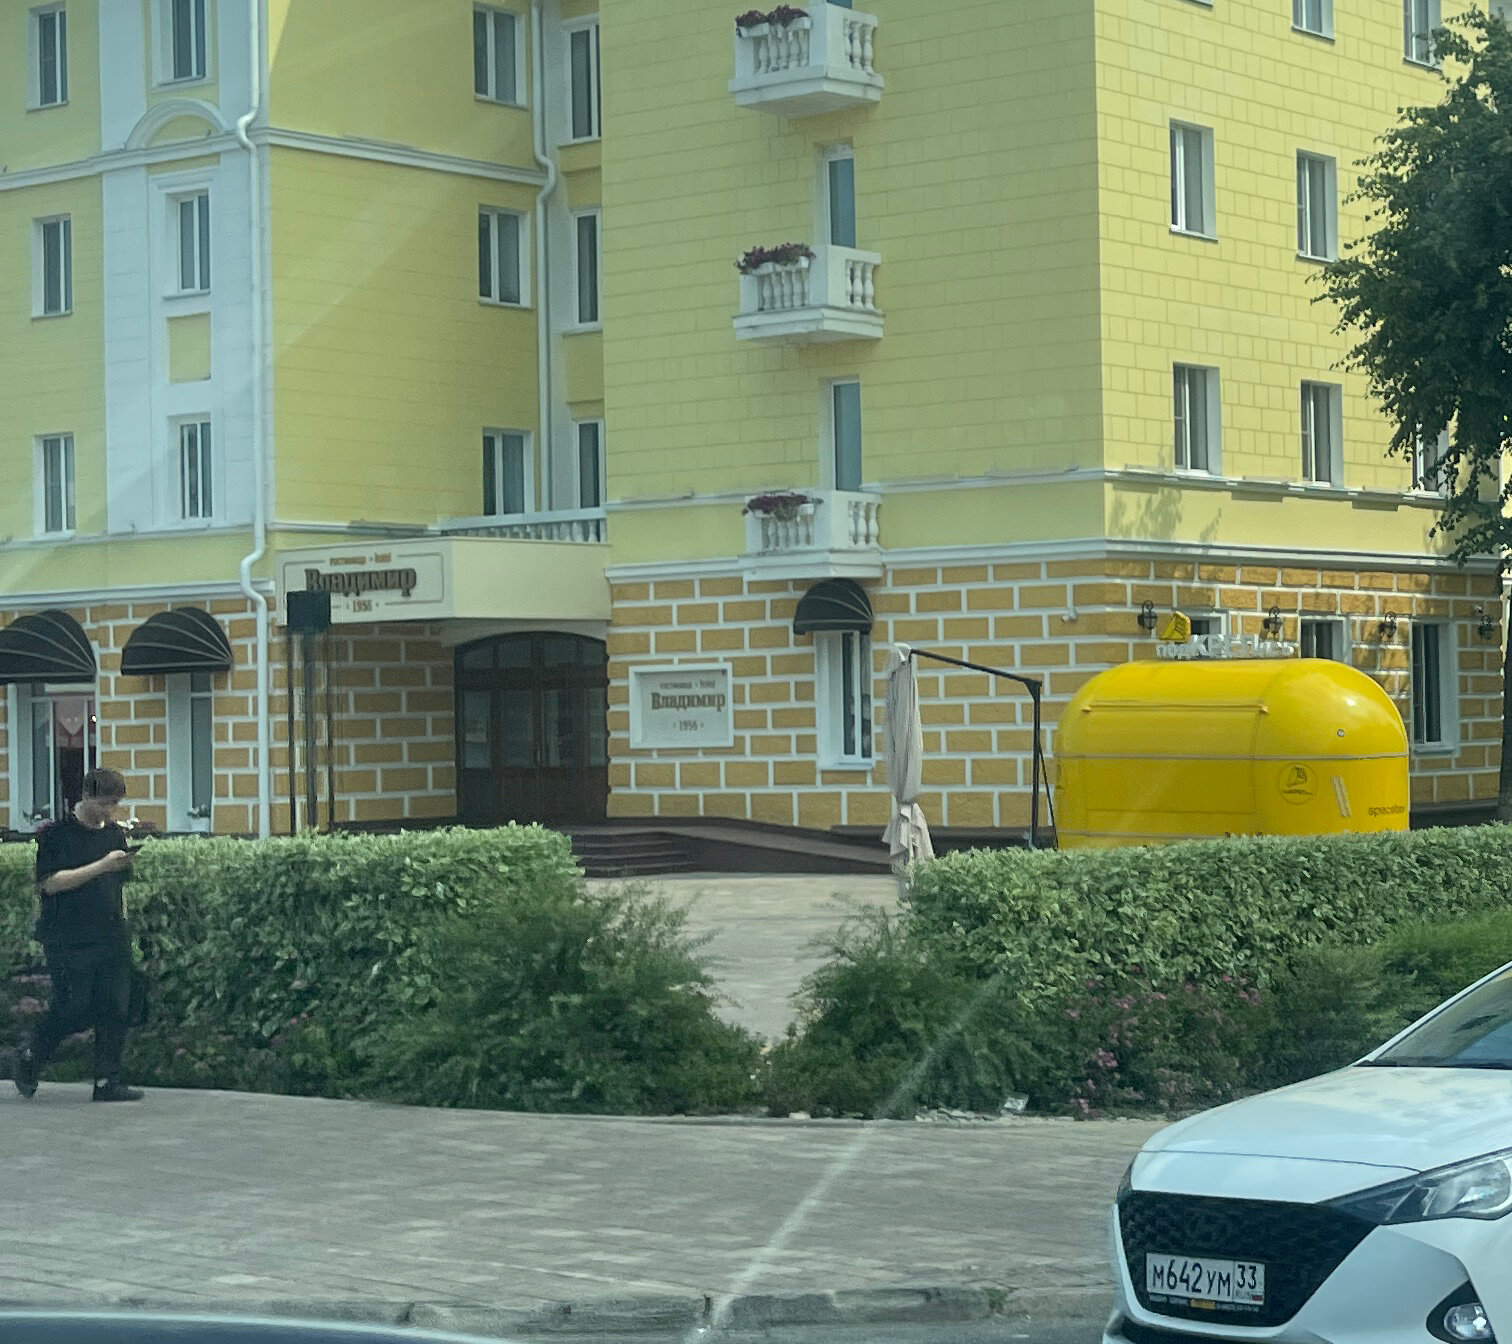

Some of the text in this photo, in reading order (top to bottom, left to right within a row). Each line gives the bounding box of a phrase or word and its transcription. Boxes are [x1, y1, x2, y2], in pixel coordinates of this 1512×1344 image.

[304, 568, 417, 598] Владимир
[353, 599, 373, 613] 1956
[650, 691, 726, 713] Владимир
[679, 720, 698, 732] 1956
[1152, 1259, 1257, 1297] М642УМ 33
